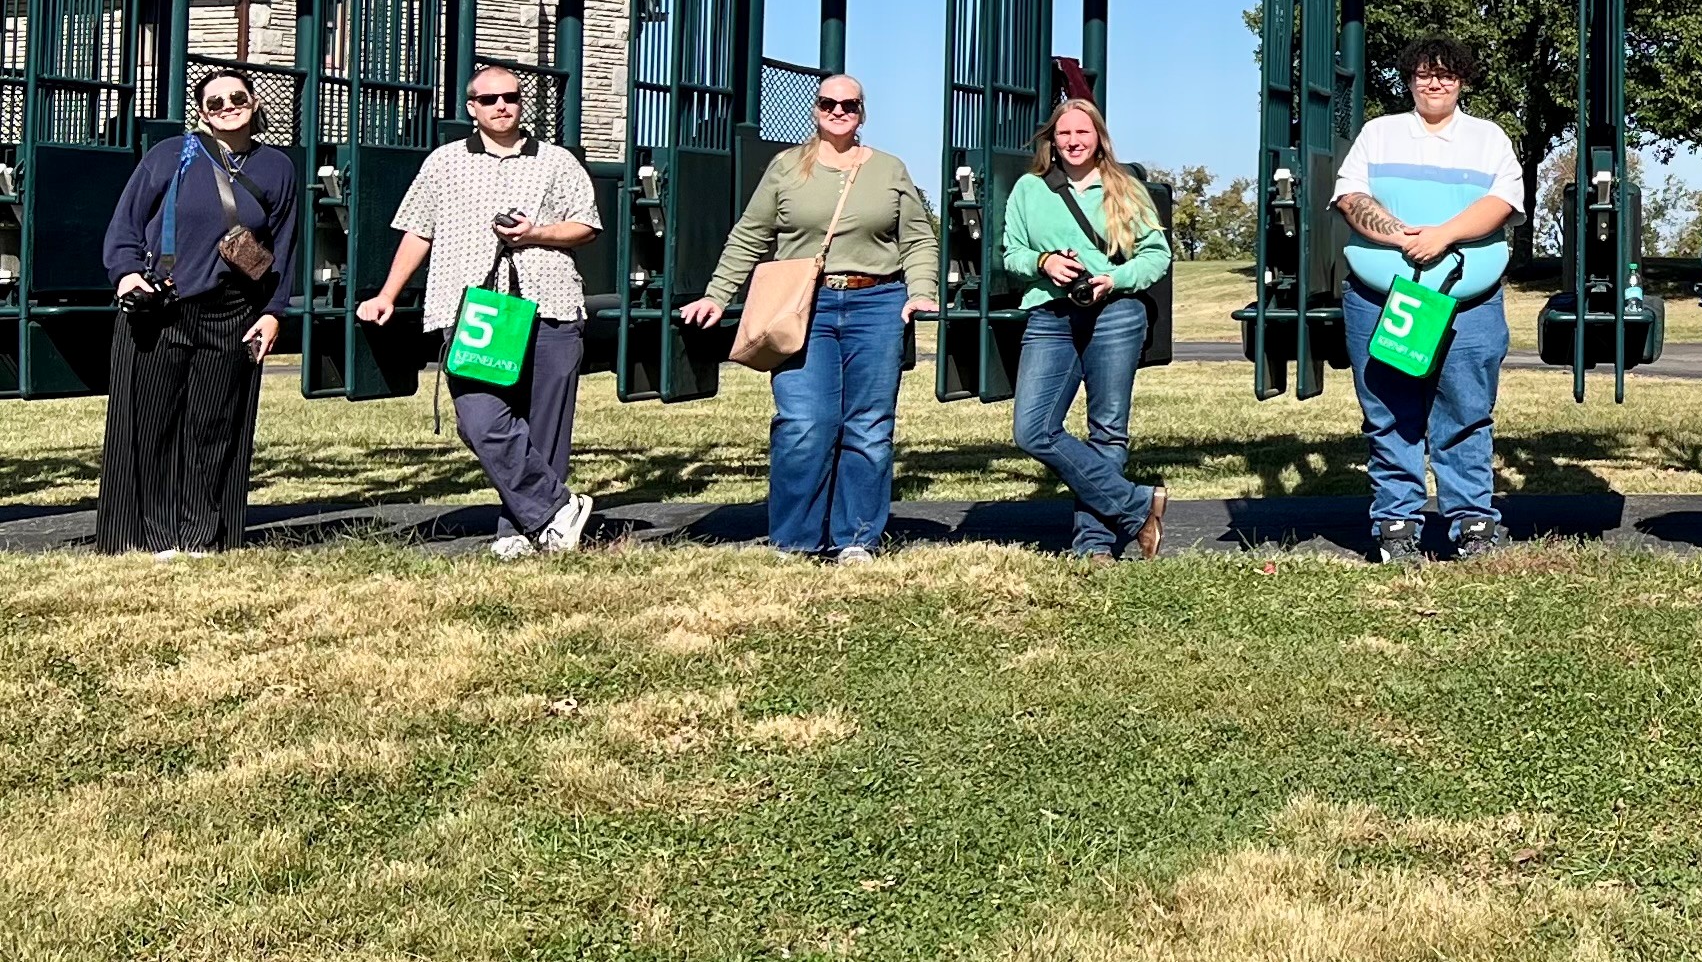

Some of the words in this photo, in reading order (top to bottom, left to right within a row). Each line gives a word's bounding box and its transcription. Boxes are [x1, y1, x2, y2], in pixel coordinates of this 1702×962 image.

[458, 302, 499, 349] 5
[1383, 291, 1422, 338] 5
[454, 349, 518, 371] KEENELAND
